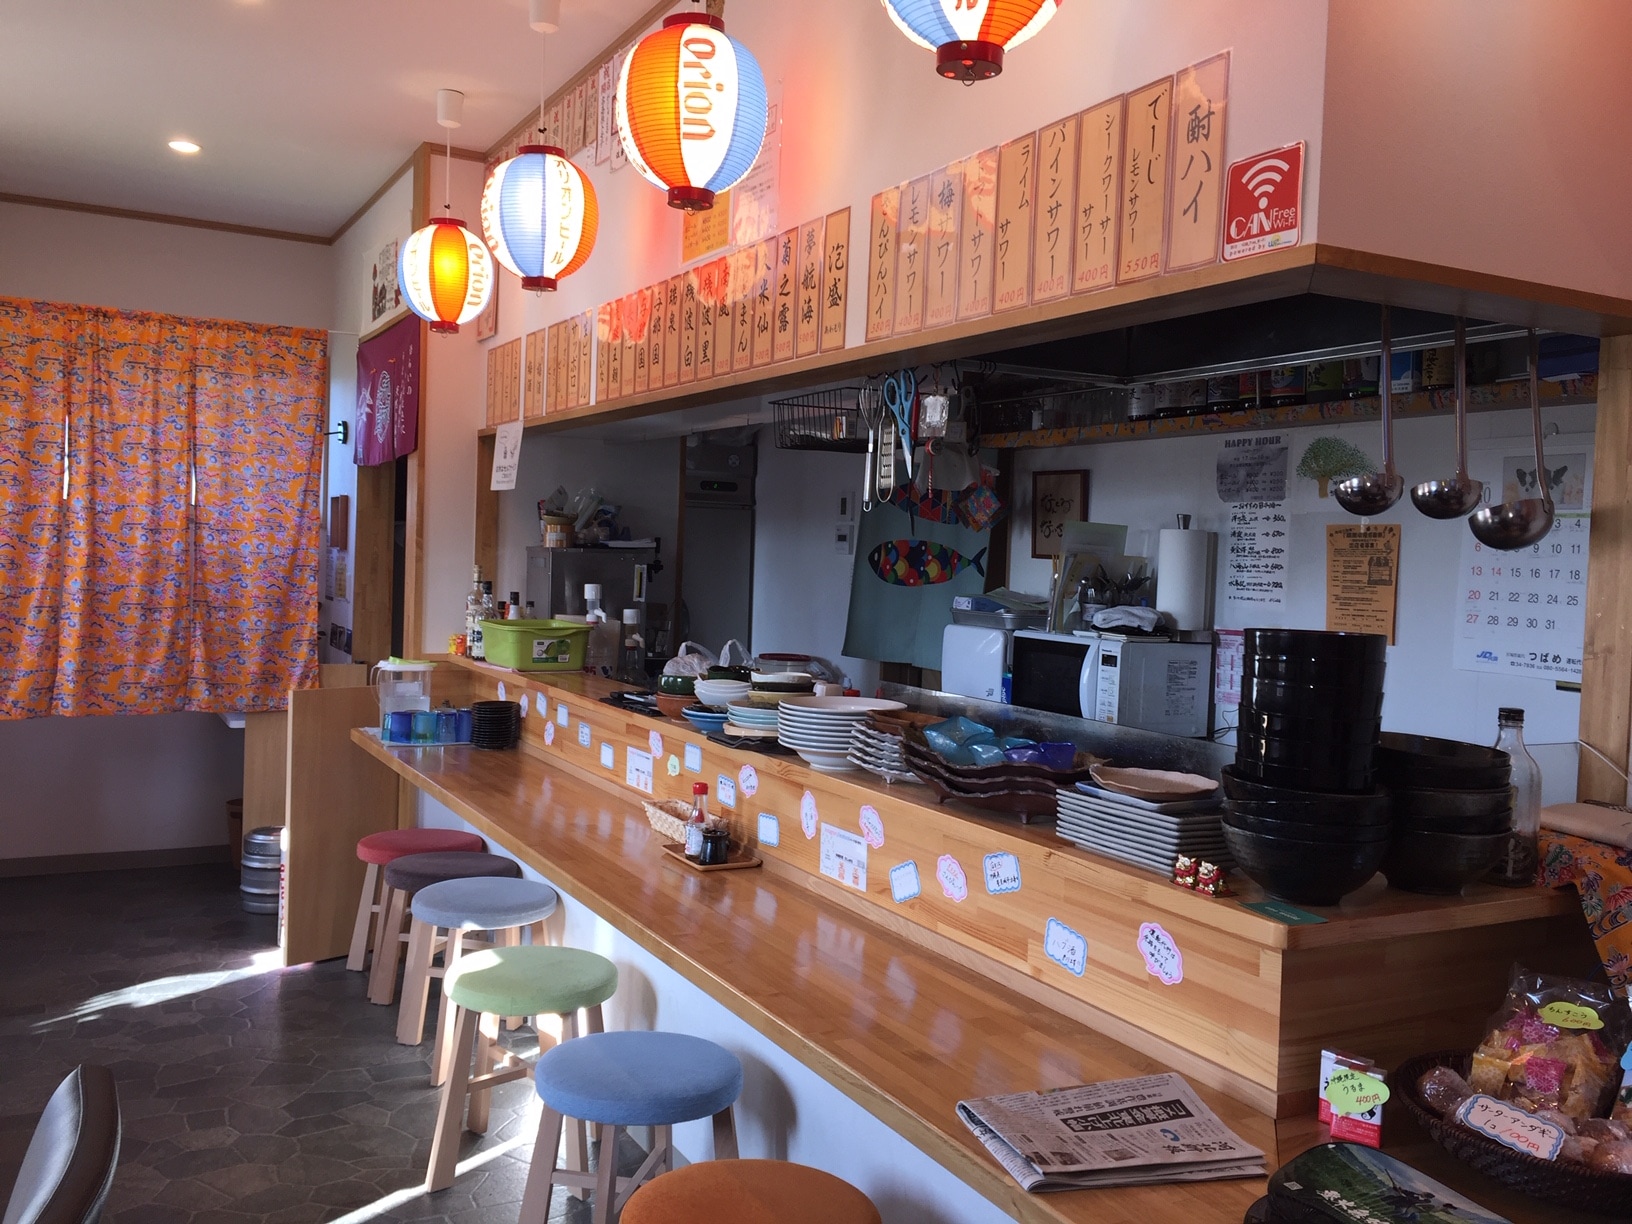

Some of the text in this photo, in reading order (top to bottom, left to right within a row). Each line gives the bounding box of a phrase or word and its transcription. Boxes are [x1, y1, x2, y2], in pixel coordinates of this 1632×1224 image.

[1148, 88, 1168, 185] でーじ
[1181, 99, 1215, 224] 酎ハイ
[1018, 144, 1030, 210] ライム
[1100, 114, 1116, 255] シークワーサー
[1047, 123, 1067, 286] パインサワー
[1129, 148, 1142, 244] レモンサワー
[1273, 207, 1296, 219] Free
[971, 160, 985, 301] トマトサワー
[1273, 216, 1296, 229] Wi-Fi
[937, 179, 955, 299] 梅サワー
[1082, 204, 1095, 261] サワー
[906, 186, 920, 315] レモンサワー
[999, 218, 1011, 282] サワー
[1229, 246, 1256, 257] powered
[1124, 252, 1159, 274] 550円
[801, 228, 817, 325] 夢航海
[827, 243, 845, 309] 泡盛
[1078, 263, 1109, 282] 400円
[777, 237, 791, 333] 菊之露
[1037, 274, 1064, 292] 400円
[964, 296, 989, 312] 400円
[1000, 286, 1025, 304] 400円
[798, 330, 816, 343] 500円
[824, 321, 842, 335] あわもり
[775, 340, 791, 352] 500円
[1225, 436, 1281, 448] HAPPY HOUR
[1554, 518, 1582, 529] 3 4
[1475, 542, 1582, 554] 6 9 10 11
[1471, 566, 1580, 580] 13 14 15 16 17 18
[1468, 590, 1579, 606] 20 21 22 23 24 25
[1466, 614, 1555, 630] 27 28 29 30 31
[1529, 652, 1562, 664] つばめ
[1562, 1016, 1592, 1028] 600円
[1342, 1083, 1366, 1096] うるま
[1356, 1092, 1381, 1106] 400円
[1499, 1128, 1540, 1152] 100円
